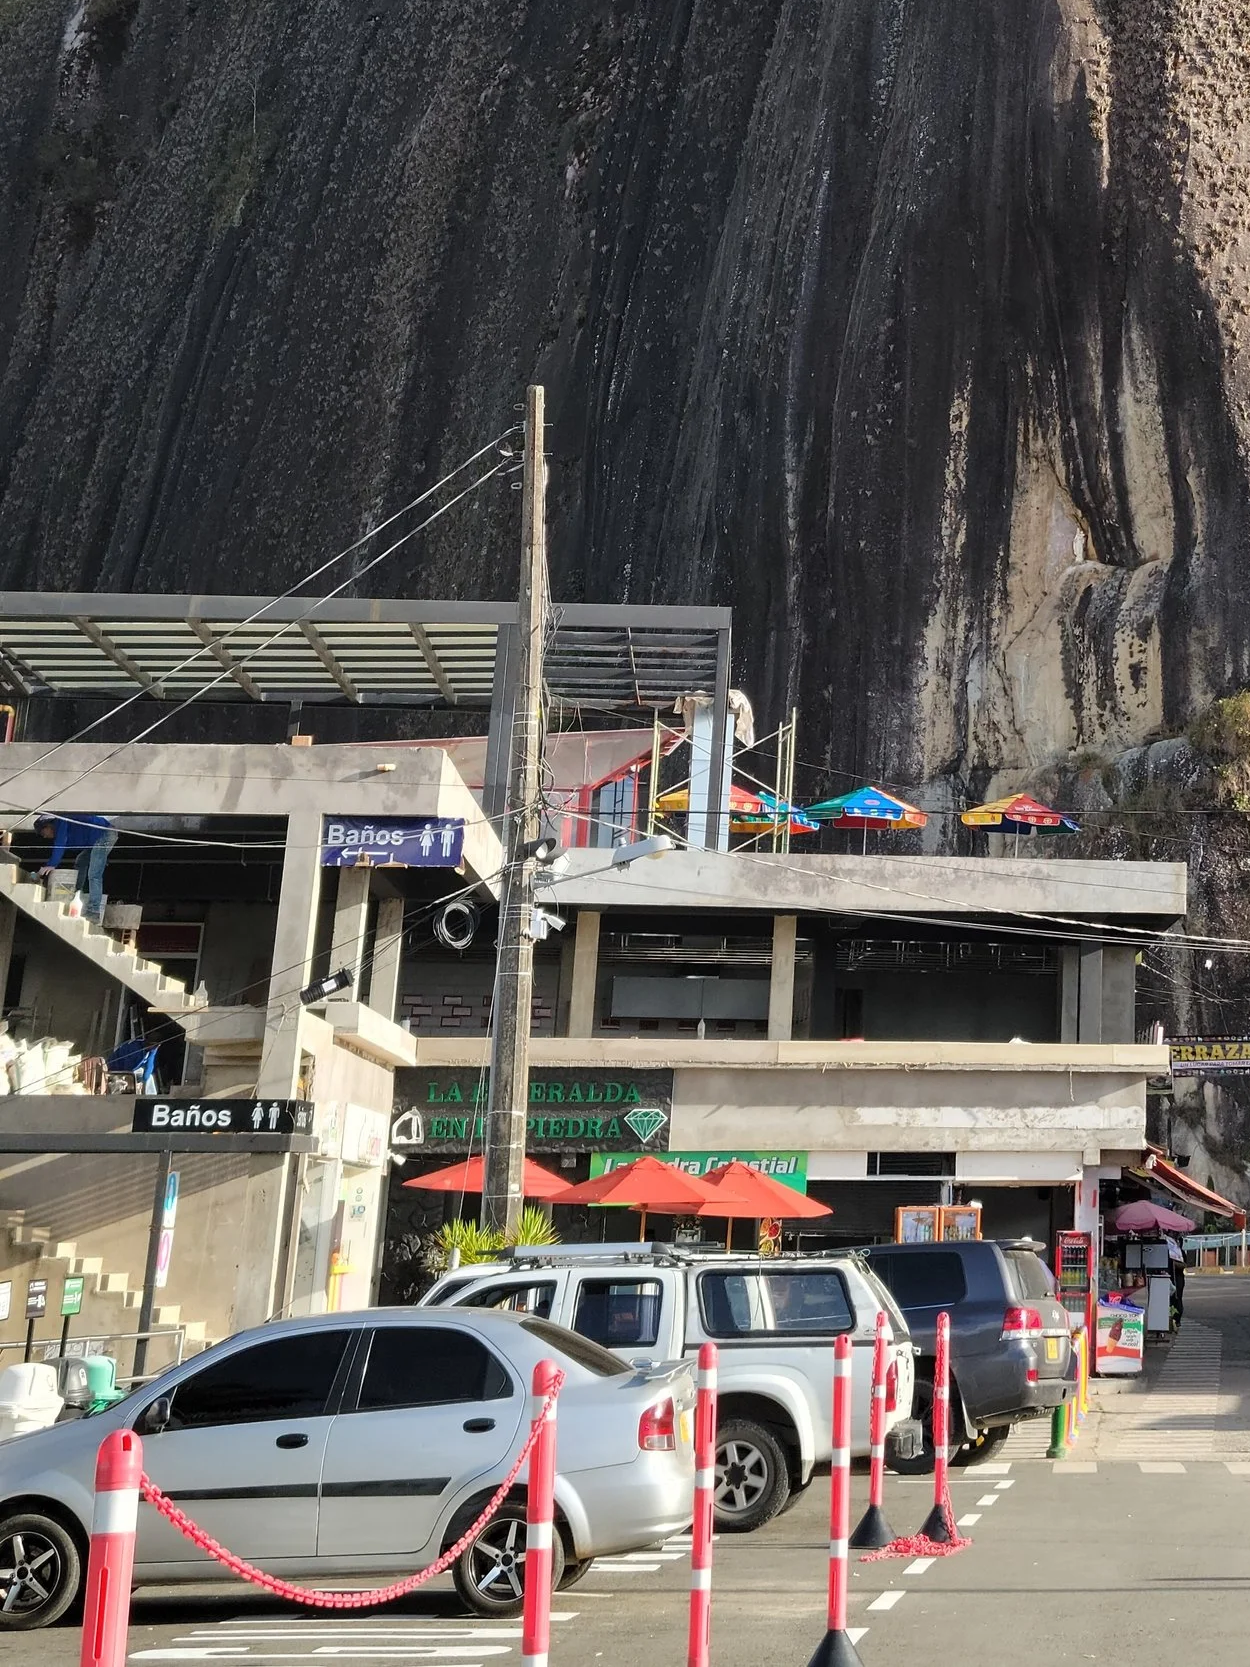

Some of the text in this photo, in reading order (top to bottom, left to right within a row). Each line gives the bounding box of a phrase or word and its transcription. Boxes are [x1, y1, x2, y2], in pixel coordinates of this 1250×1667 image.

[327, 823, 405, 846] Baños
[426, 1081, 642, 1103] LA EERALDA
[151, 1103, 233, 1127] Baños
[430, 1117, 470, 1139] EN
